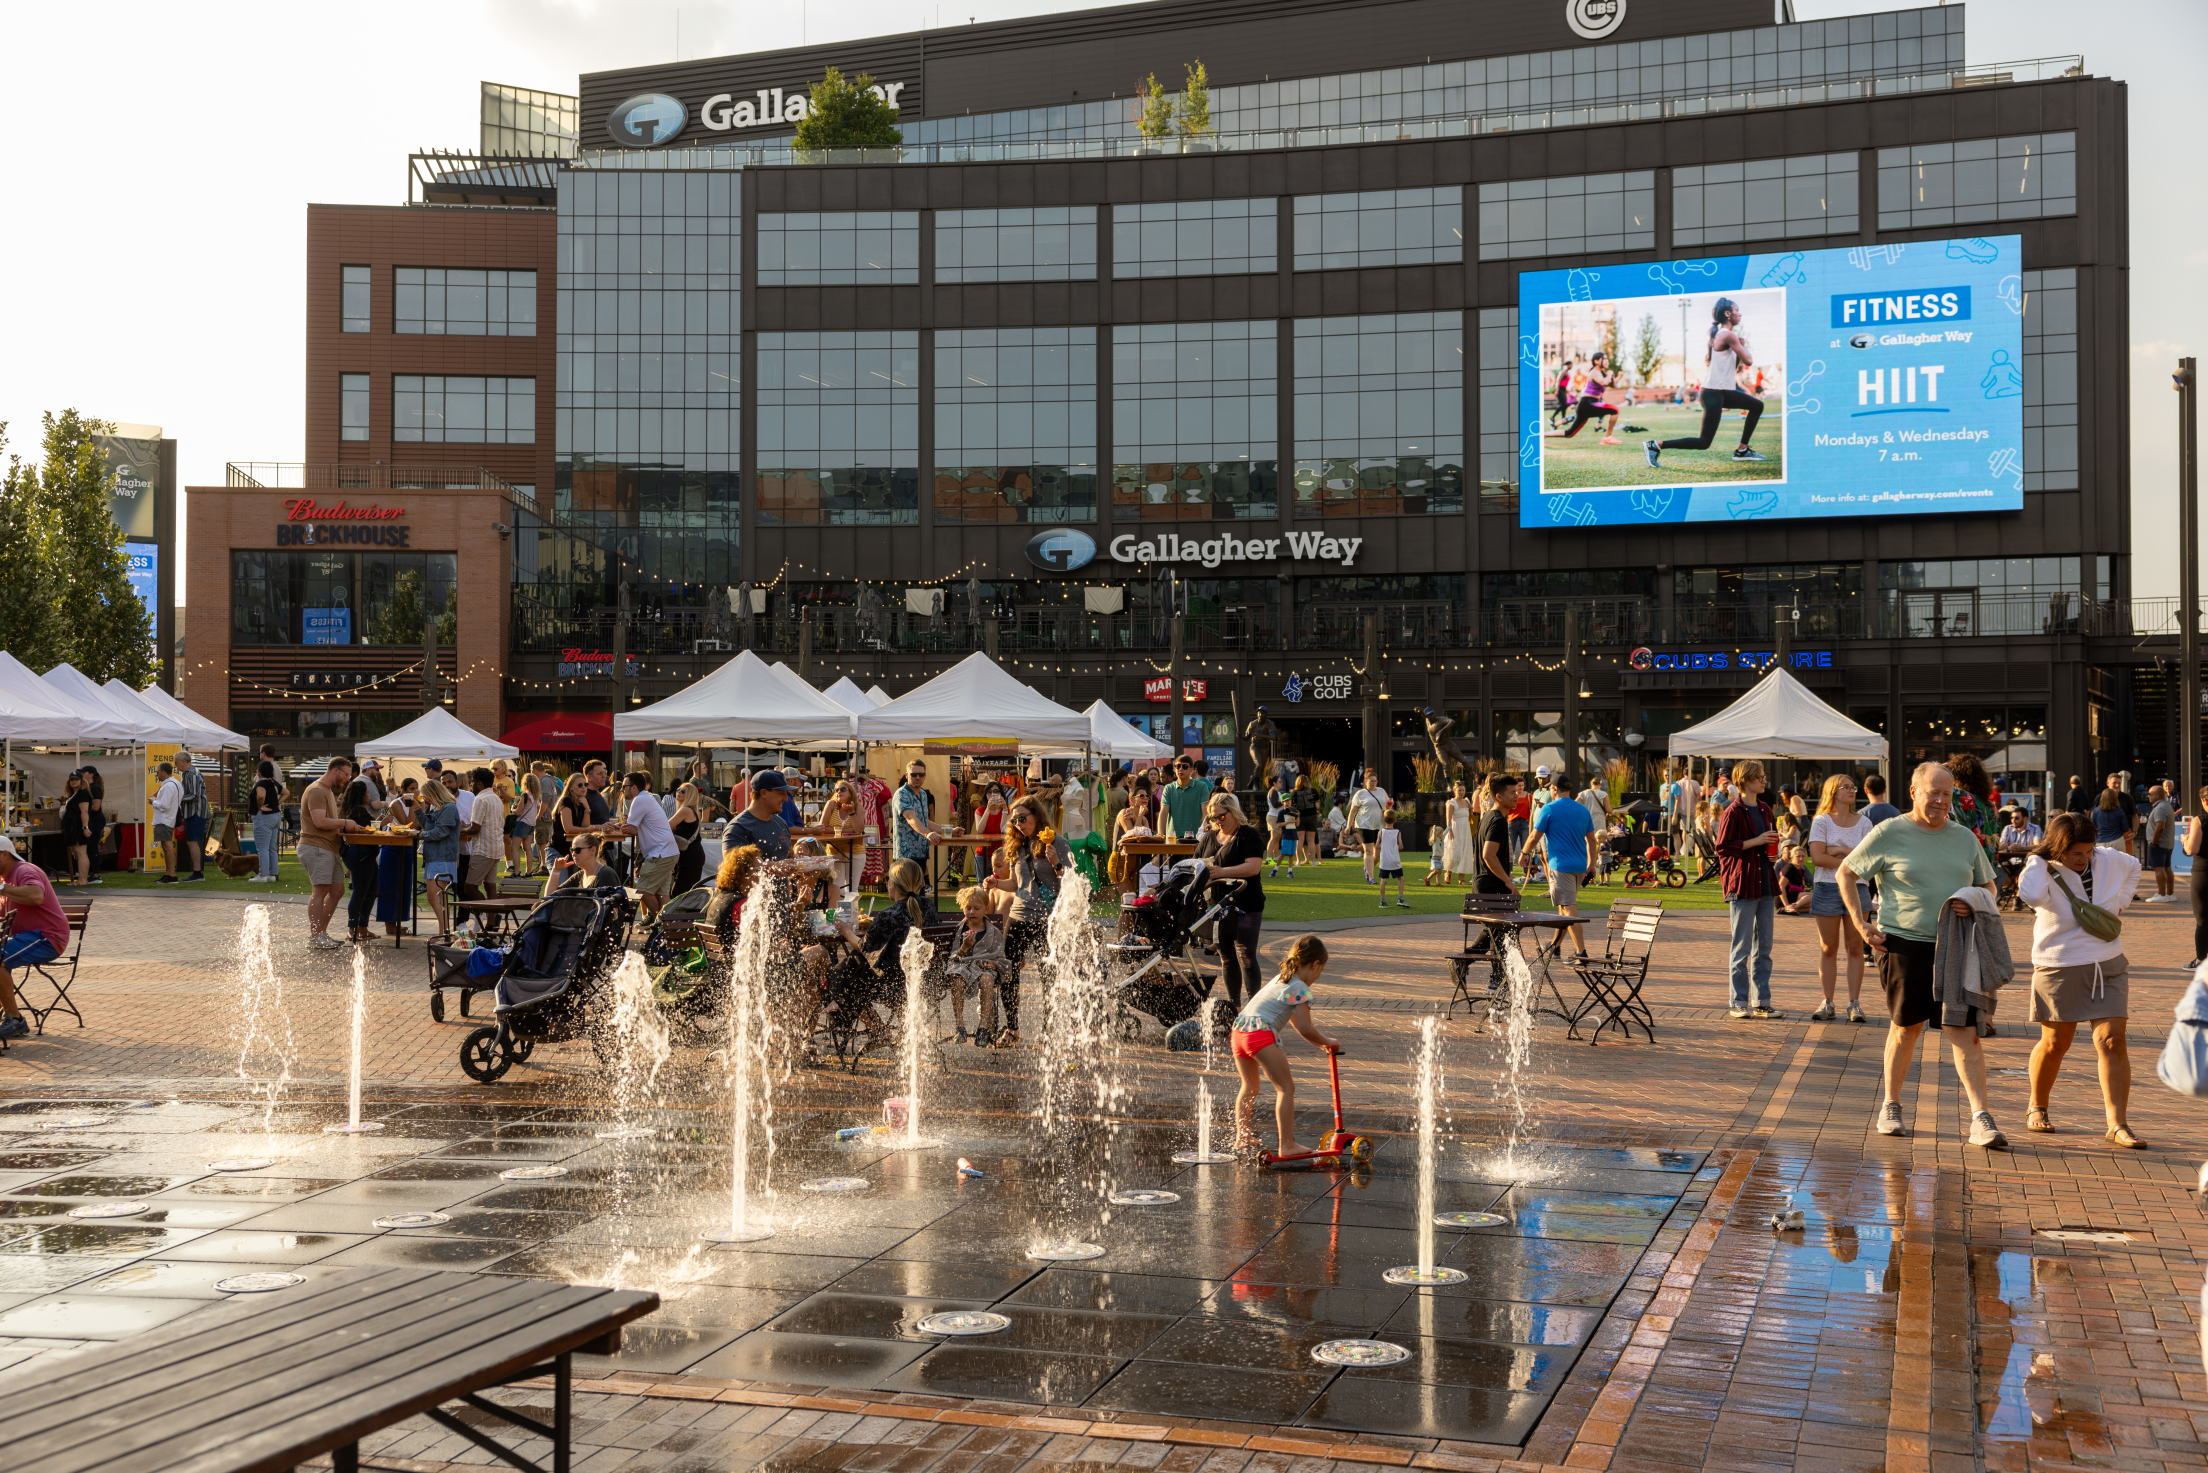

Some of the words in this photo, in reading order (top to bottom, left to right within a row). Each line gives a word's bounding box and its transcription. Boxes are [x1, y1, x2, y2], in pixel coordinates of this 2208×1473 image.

[1843, 292, 1959, 323] FITNESS
[1830, 339, 1841, 348] at
[1879, 332, 1942, 346] Gallagher
[1944, 330, 1974, 343] Way
[1859, 365, 1945, 405] HIIT
[1814, 432, 1879, 447] Mondays
[1883, 431, 1895, 443] &
[1898, 426, 1989, 442] Wednesdays
[1878, 449, 1887, 462] 7
[1891, 451, 1923, 462] a.m.
[114, 485, 138, 499] Way
[1811, 494, 1836, 503] More
[1838, 493, 1856, 503] info
[1857, 493, 1870, 502] at:
[1871, 489, 1994, 503] gallagherway.com/events
[283, 498, 405, 521] Budweiser
[1109, 533, 1280, 568] Gallagher
[1285, 531, 1362, 565] Way
[1653, 653, 1729, 669] CUBS
[1146, 678, 1205, 695] MARUEE
[1313, 675, 1352, 687] CUBS
[1313, 687, 1352, 699] GOLF
